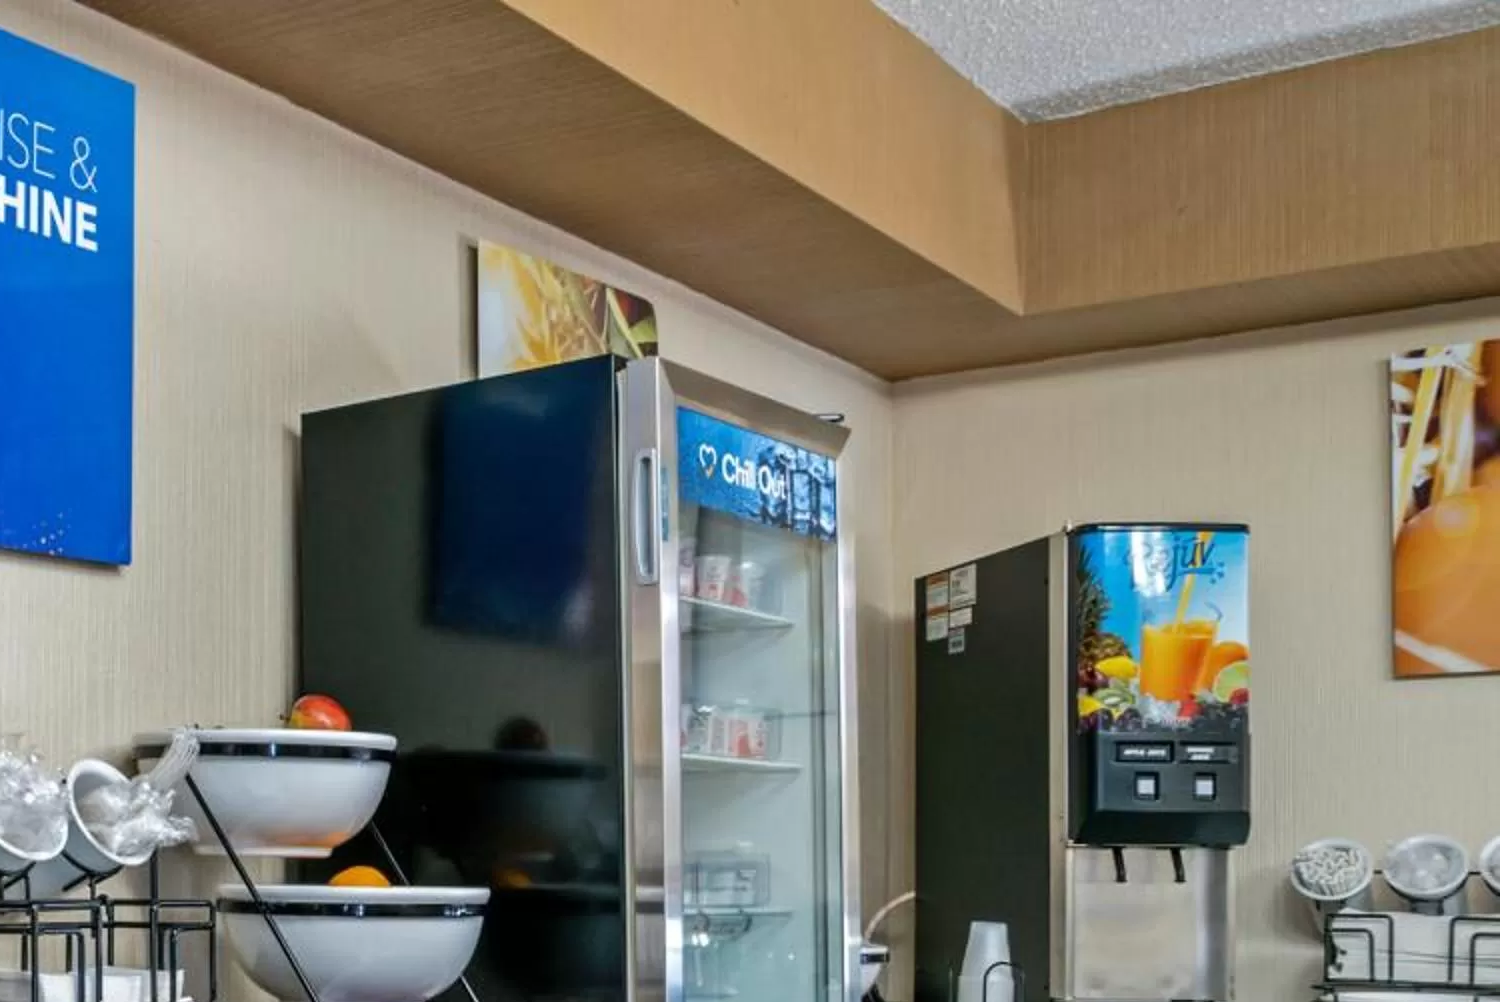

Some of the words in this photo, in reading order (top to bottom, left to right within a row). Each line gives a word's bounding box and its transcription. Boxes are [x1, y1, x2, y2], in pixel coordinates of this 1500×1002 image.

[69, 136, 98, 193] &
[721, 452, 757, 491] Chill
[757, 464, 787, 500] Out
